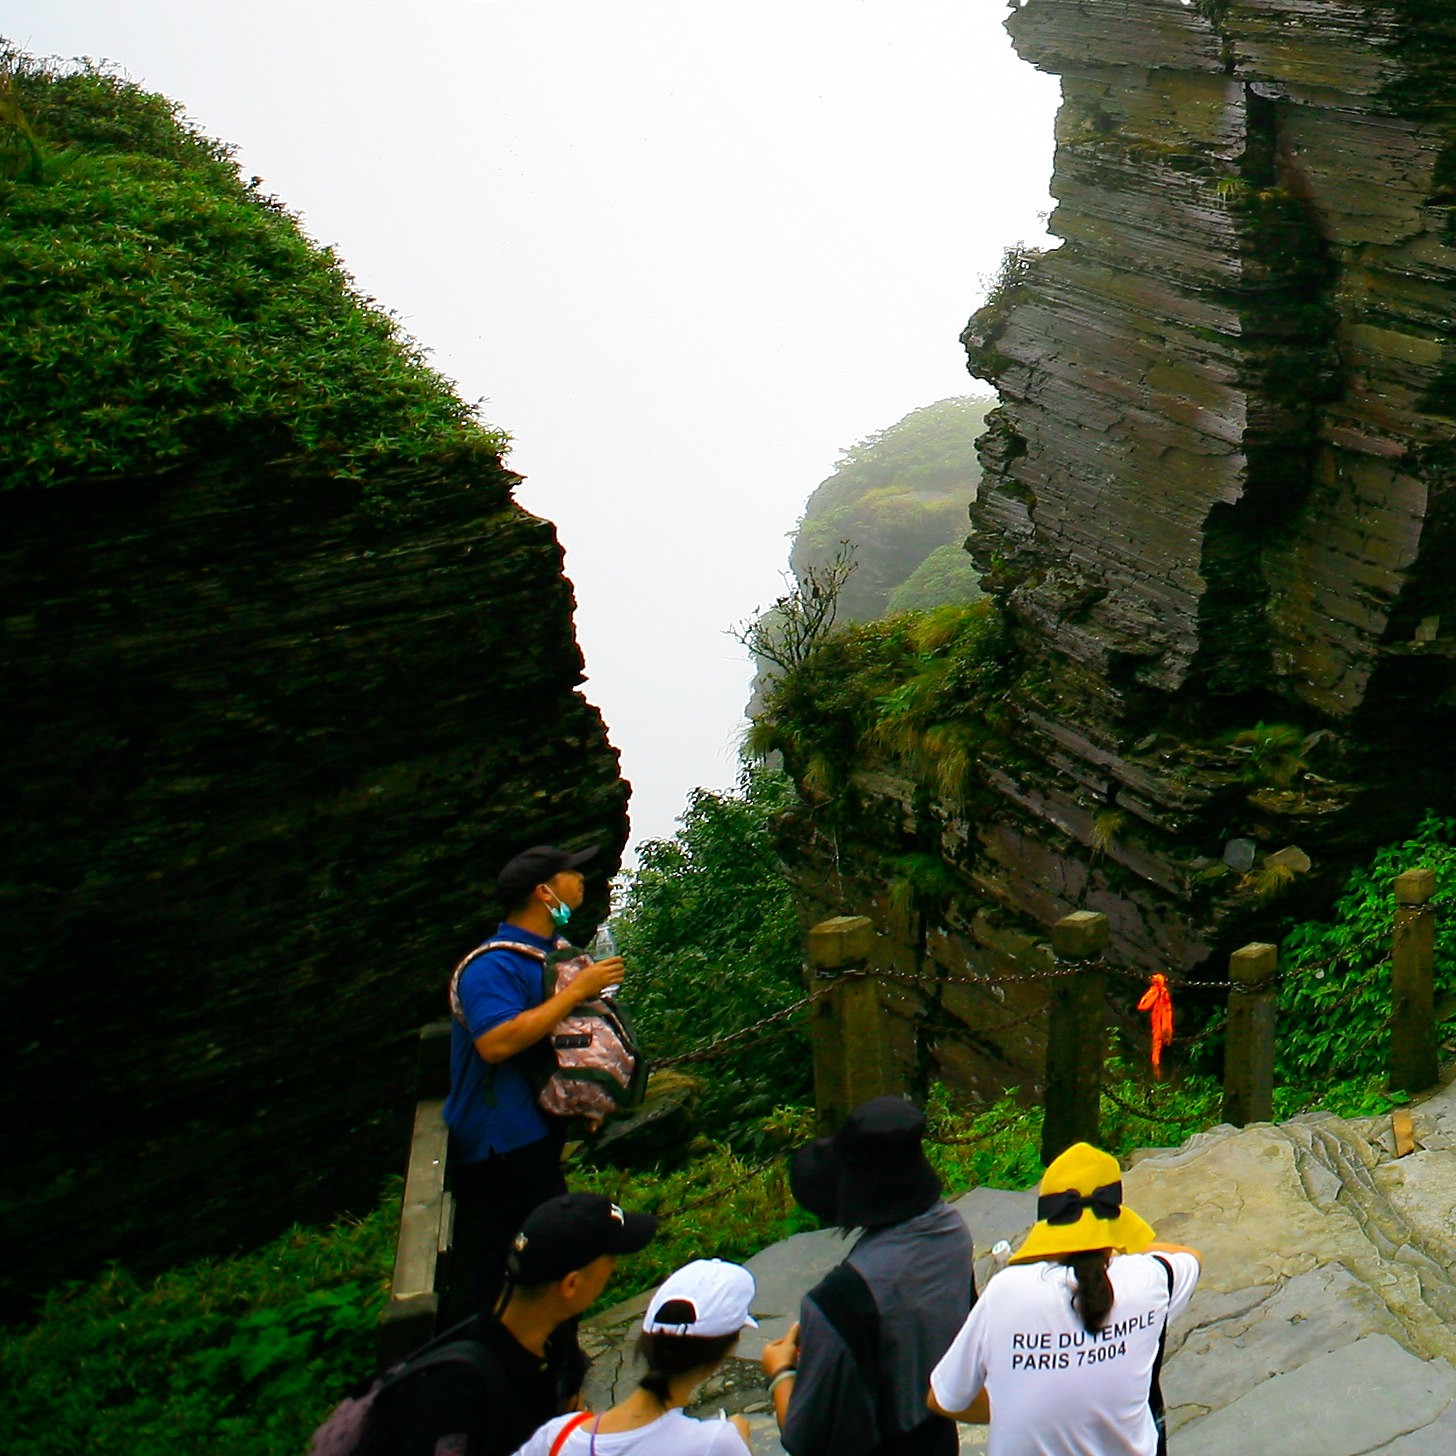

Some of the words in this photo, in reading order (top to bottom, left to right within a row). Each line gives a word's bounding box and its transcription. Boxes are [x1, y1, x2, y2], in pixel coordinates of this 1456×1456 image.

[1013, 1333, 1052, 1349] RUE
[1059, 1330, 1085, 1348] DU
[1012, 1353, 1070, 1370] PARIS
[1077, 1340, 1127, 1367] 75004
